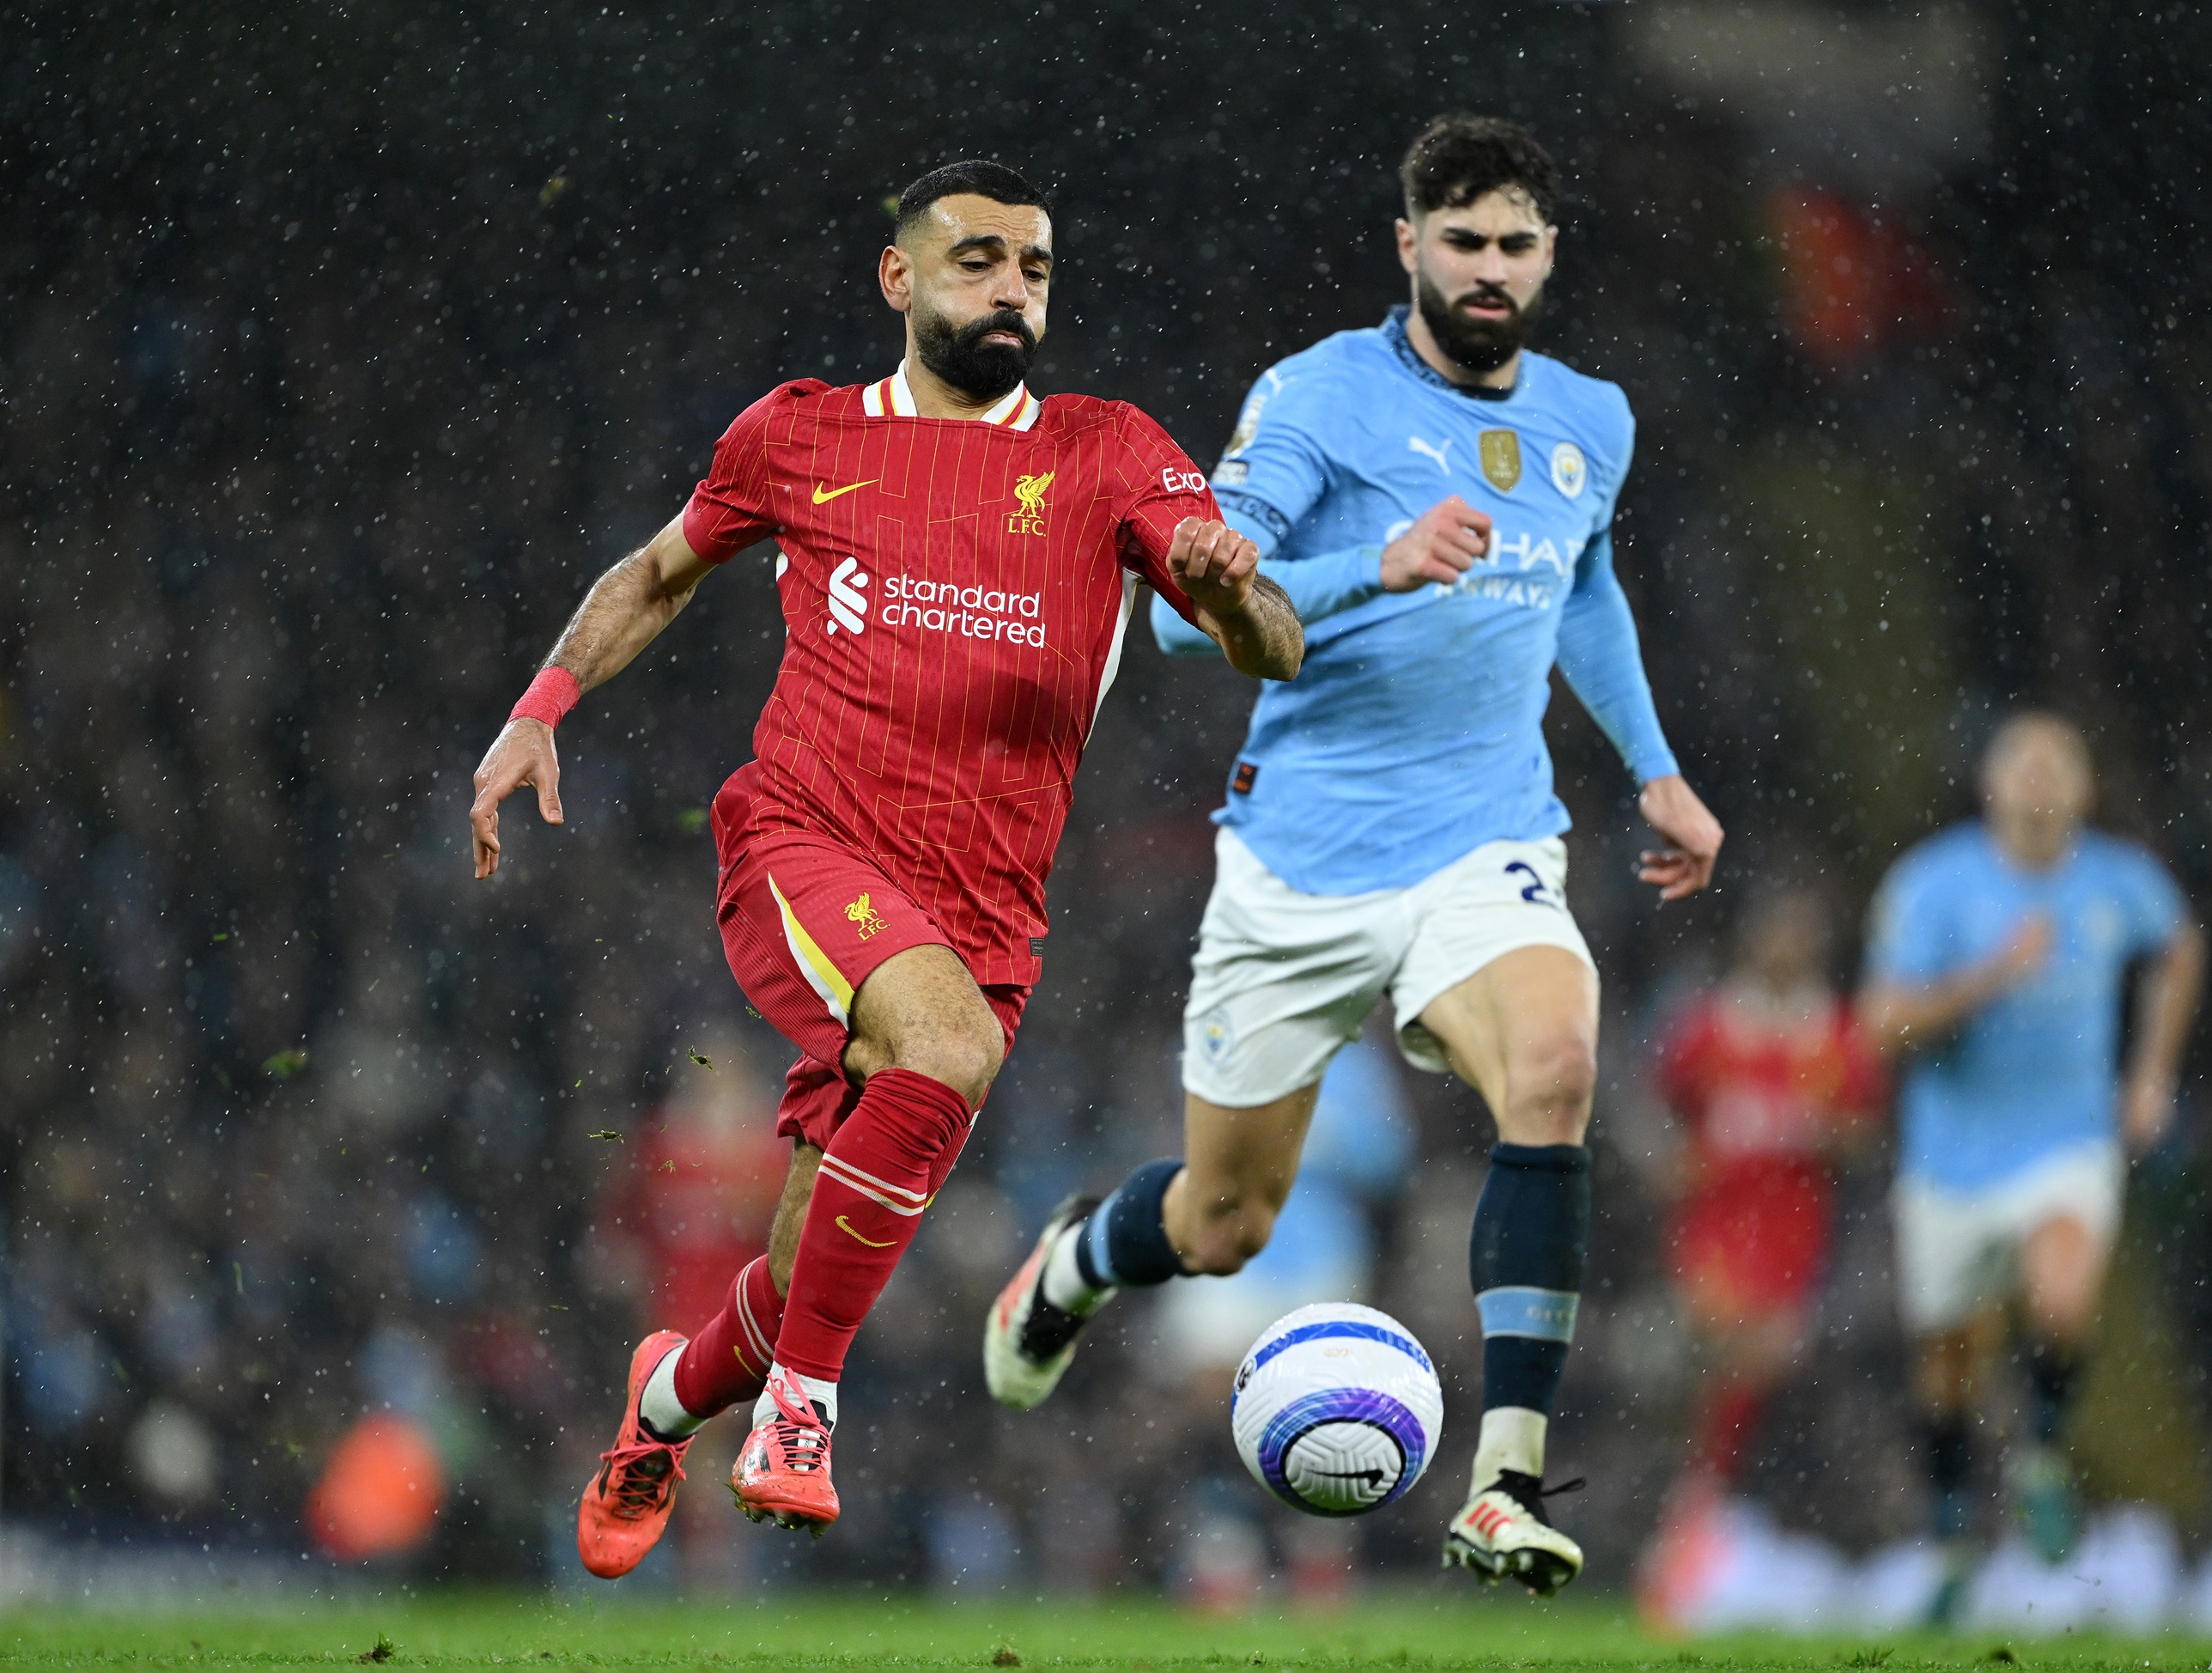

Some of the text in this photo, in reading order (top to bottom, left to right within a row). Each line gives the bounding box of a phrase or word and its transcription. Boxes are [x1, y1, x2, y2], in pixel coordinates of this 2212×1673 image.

[1007, 518, 1047, 537] L.F.C.
[884, 573, 1041, 618] standard
[882, 600, 1046, 648] chartered
[1504, 861, 1563, 912] 2
[857, 919, 891, 941] L.F.C.
